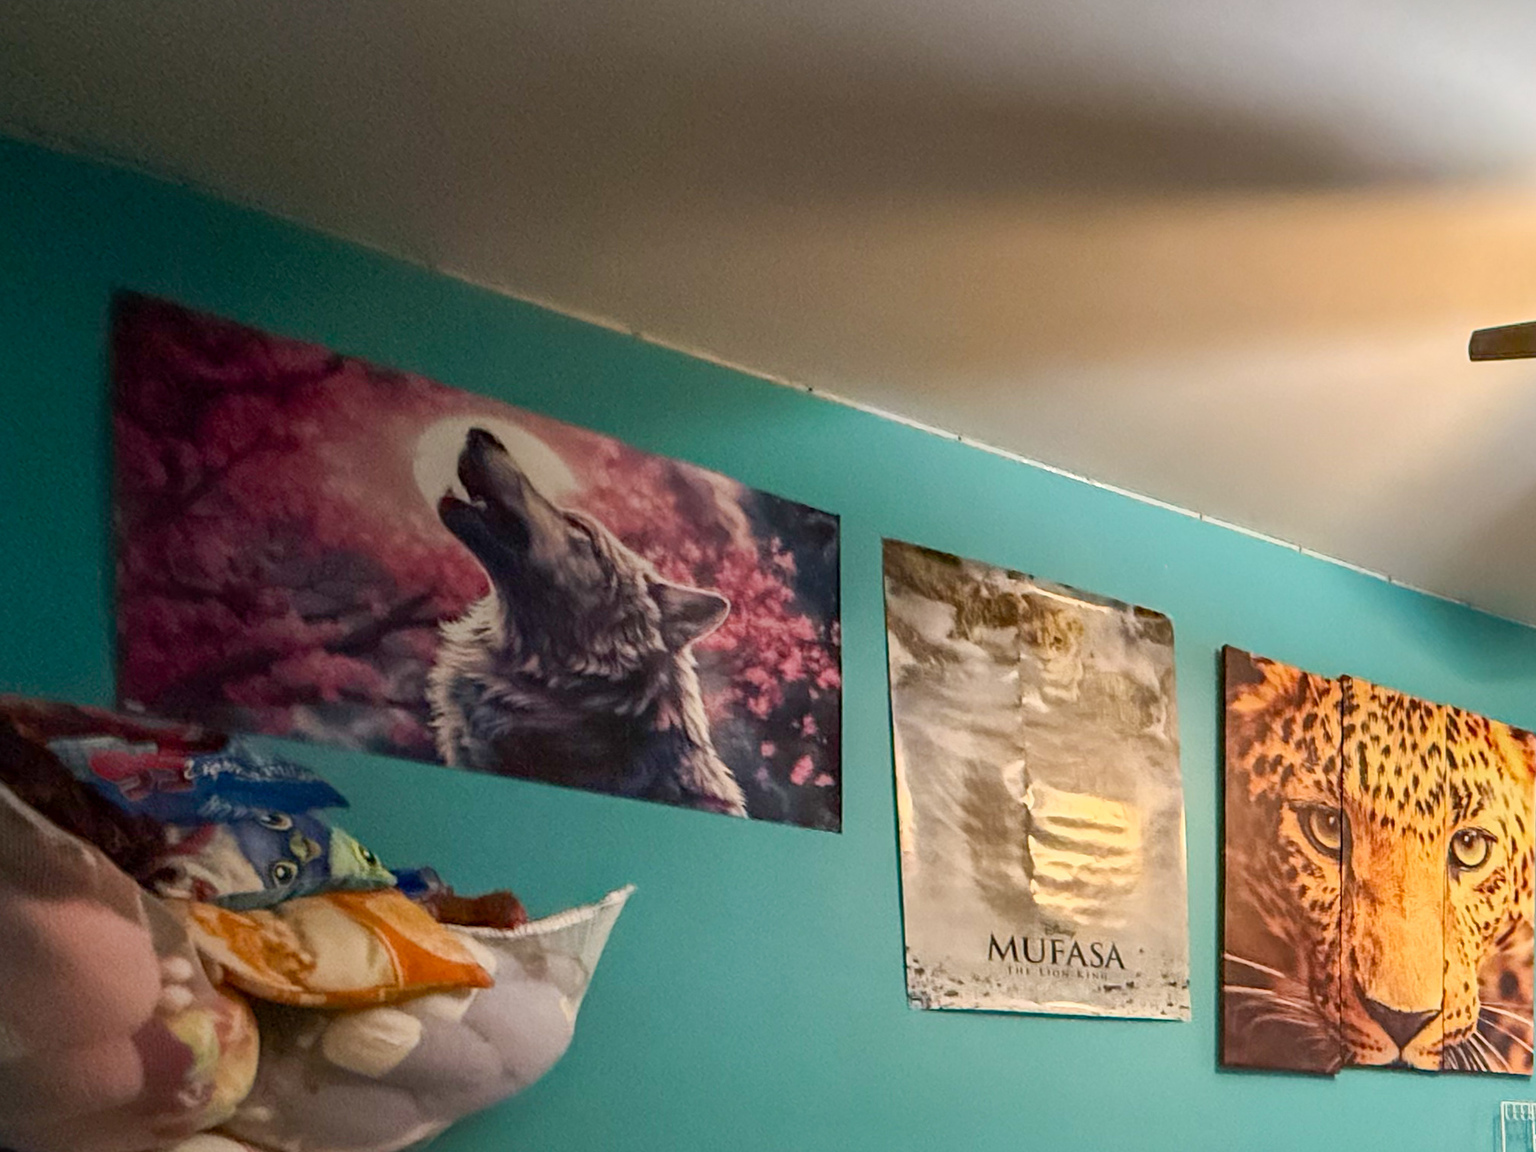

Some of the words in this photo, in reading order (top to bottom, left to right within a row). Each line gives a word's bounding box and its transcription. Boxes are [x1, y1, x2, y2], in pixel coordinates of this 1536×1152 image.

[988, 932, 1126, 970] MUFASA
[1007, 965, 1030, 976] THE
[1039, 967, 1070, 978] LION
[1076, 970, 1108, 981] KING
